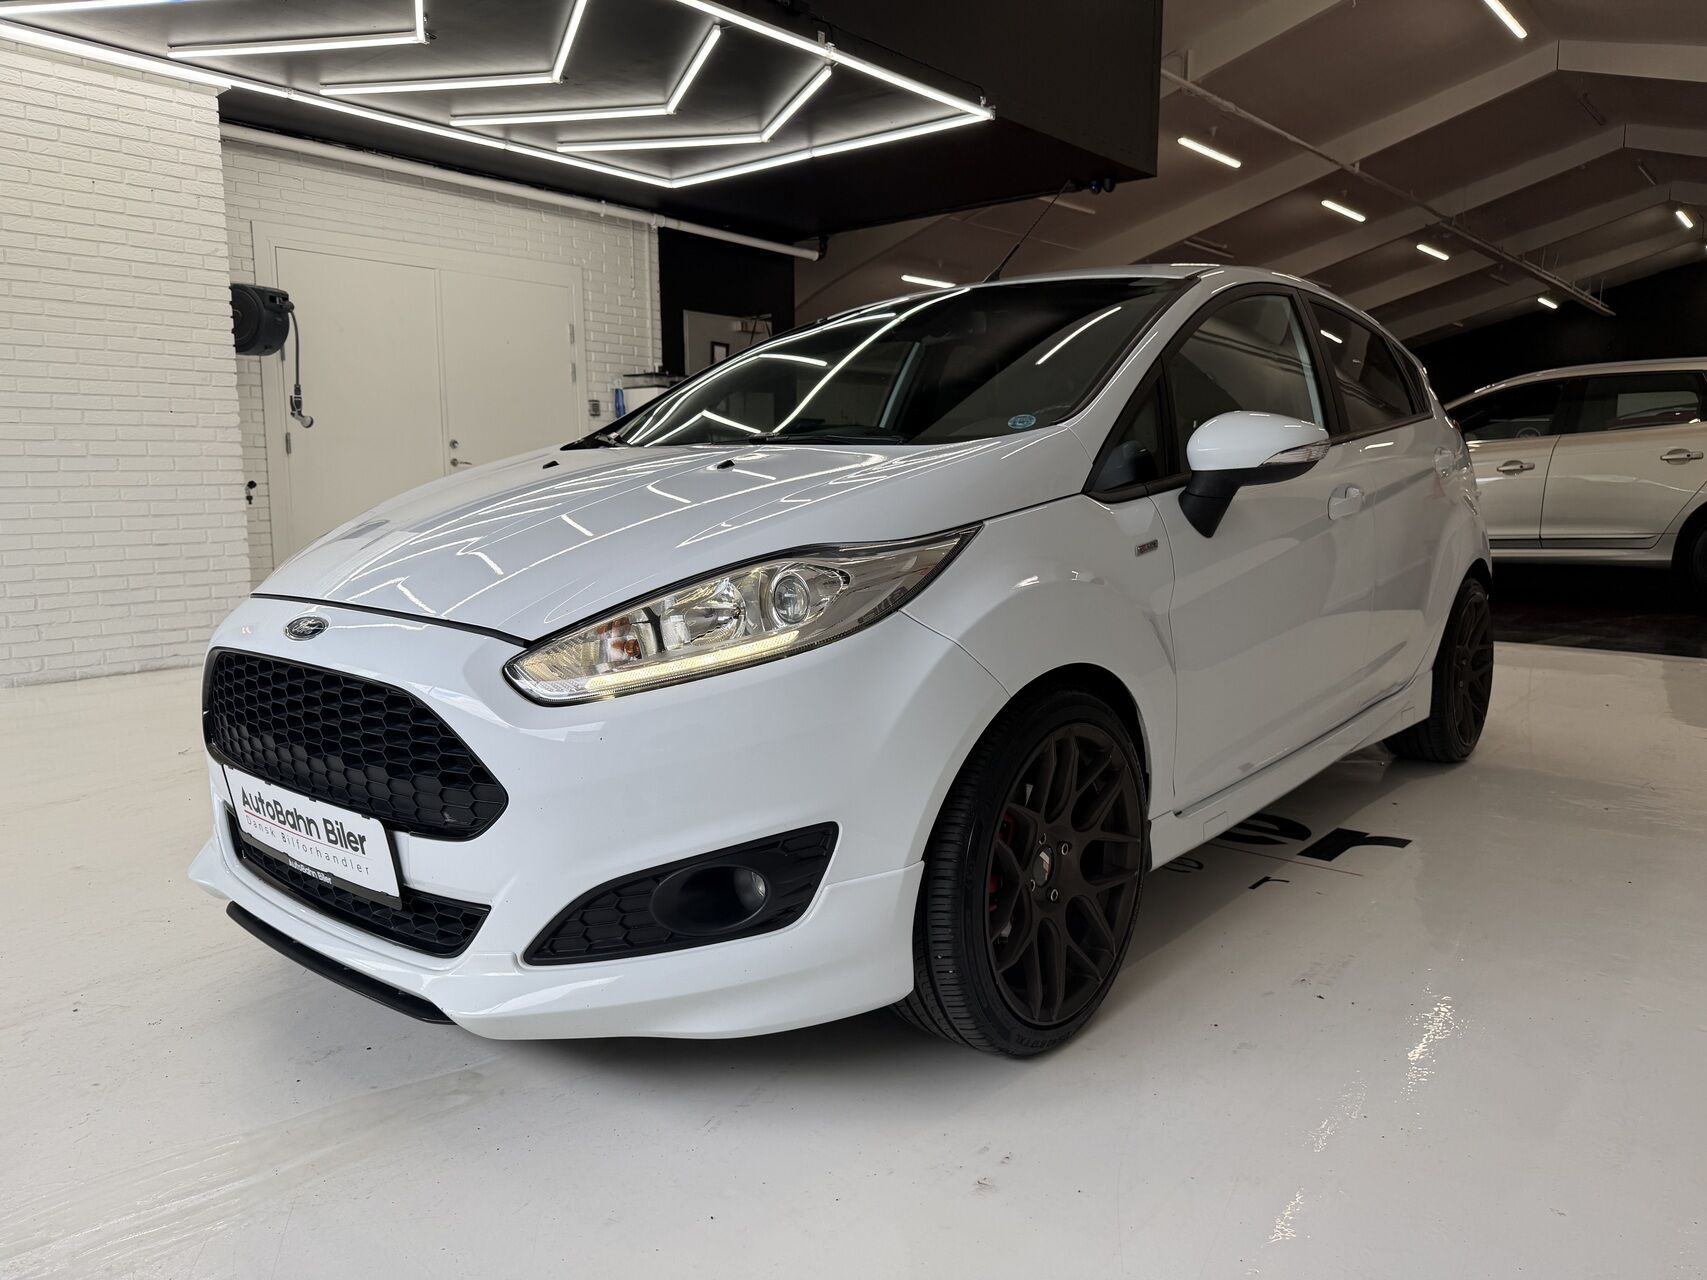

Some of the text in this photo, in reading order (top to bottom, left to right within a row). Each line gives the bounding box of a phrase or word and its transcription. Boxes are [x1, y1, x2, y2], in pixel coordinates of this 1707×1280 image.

[241, 786, 367, 855] AutoBahn Biler
[246, 815, 370, 876] Dansk Bilforhandler
